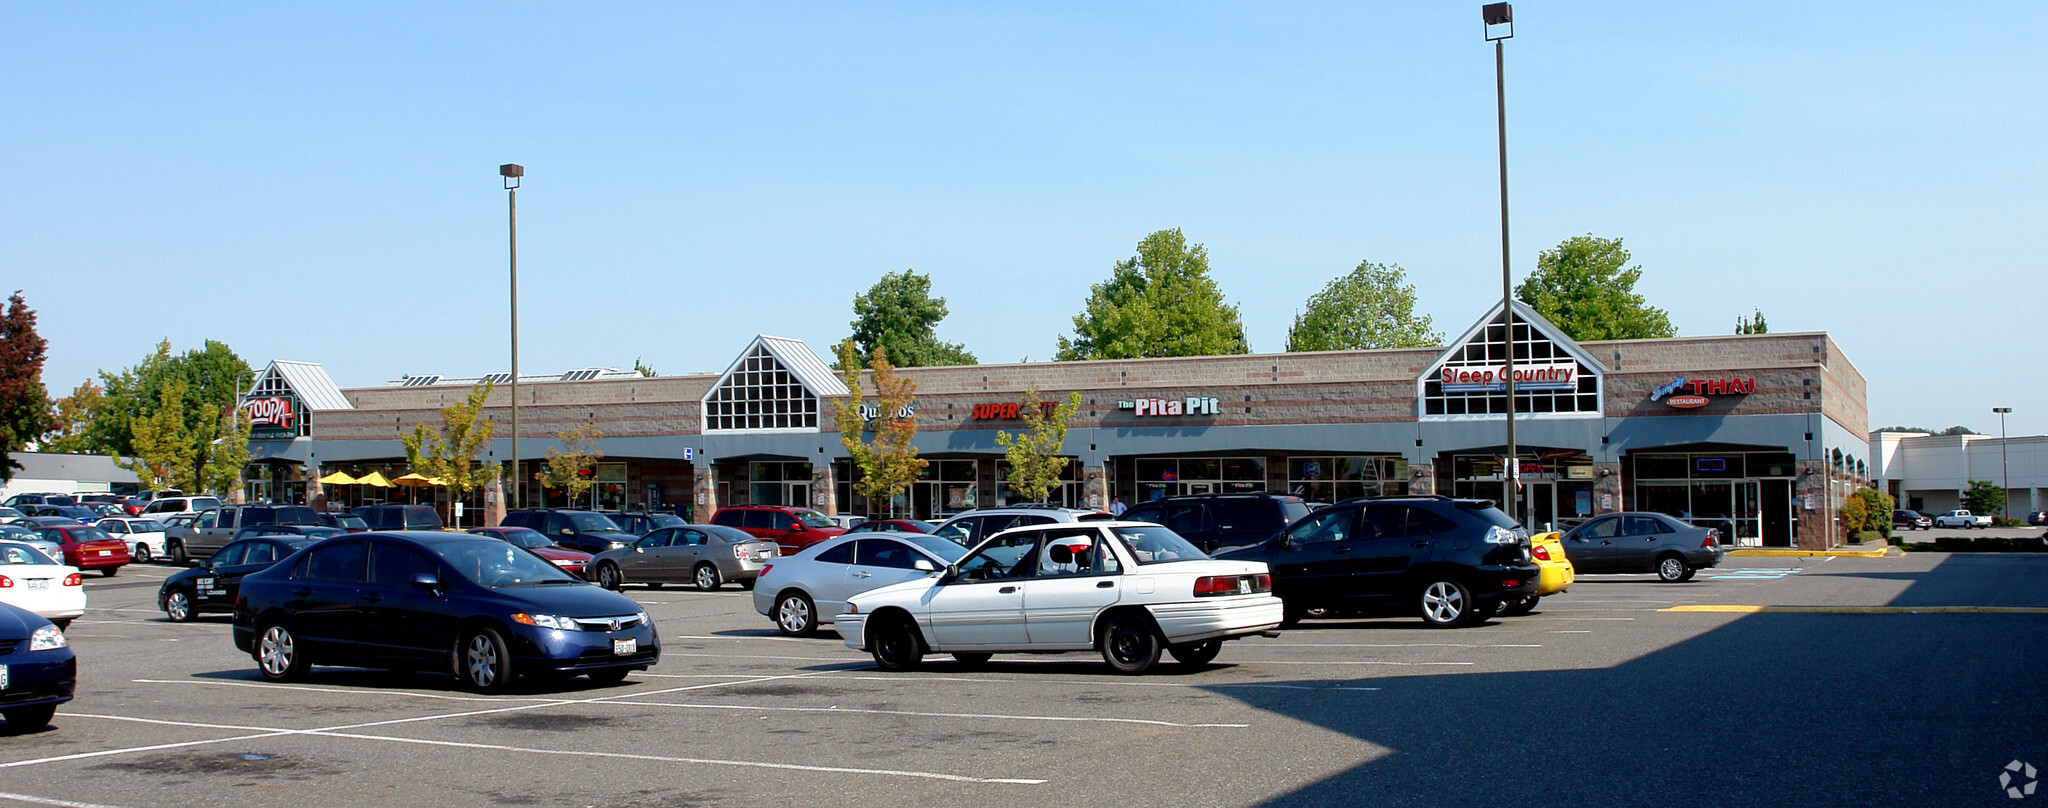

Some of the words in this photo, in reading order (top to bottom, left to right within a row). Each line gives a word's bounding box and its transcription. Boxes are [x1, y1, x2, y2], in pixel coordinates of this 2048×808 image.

[1441, 368, 1493, 385] Sleep
[1690, 377, 1755, 395] THAI
[972, 401, 1059, 419] SUPERCTS
[1117, 400, 1134, 408] The
[1135, 397, 1183, 416] Pita
[1185, 396, 1221, 415] Pit
[1519, 463, 1544, 474] OPEN
